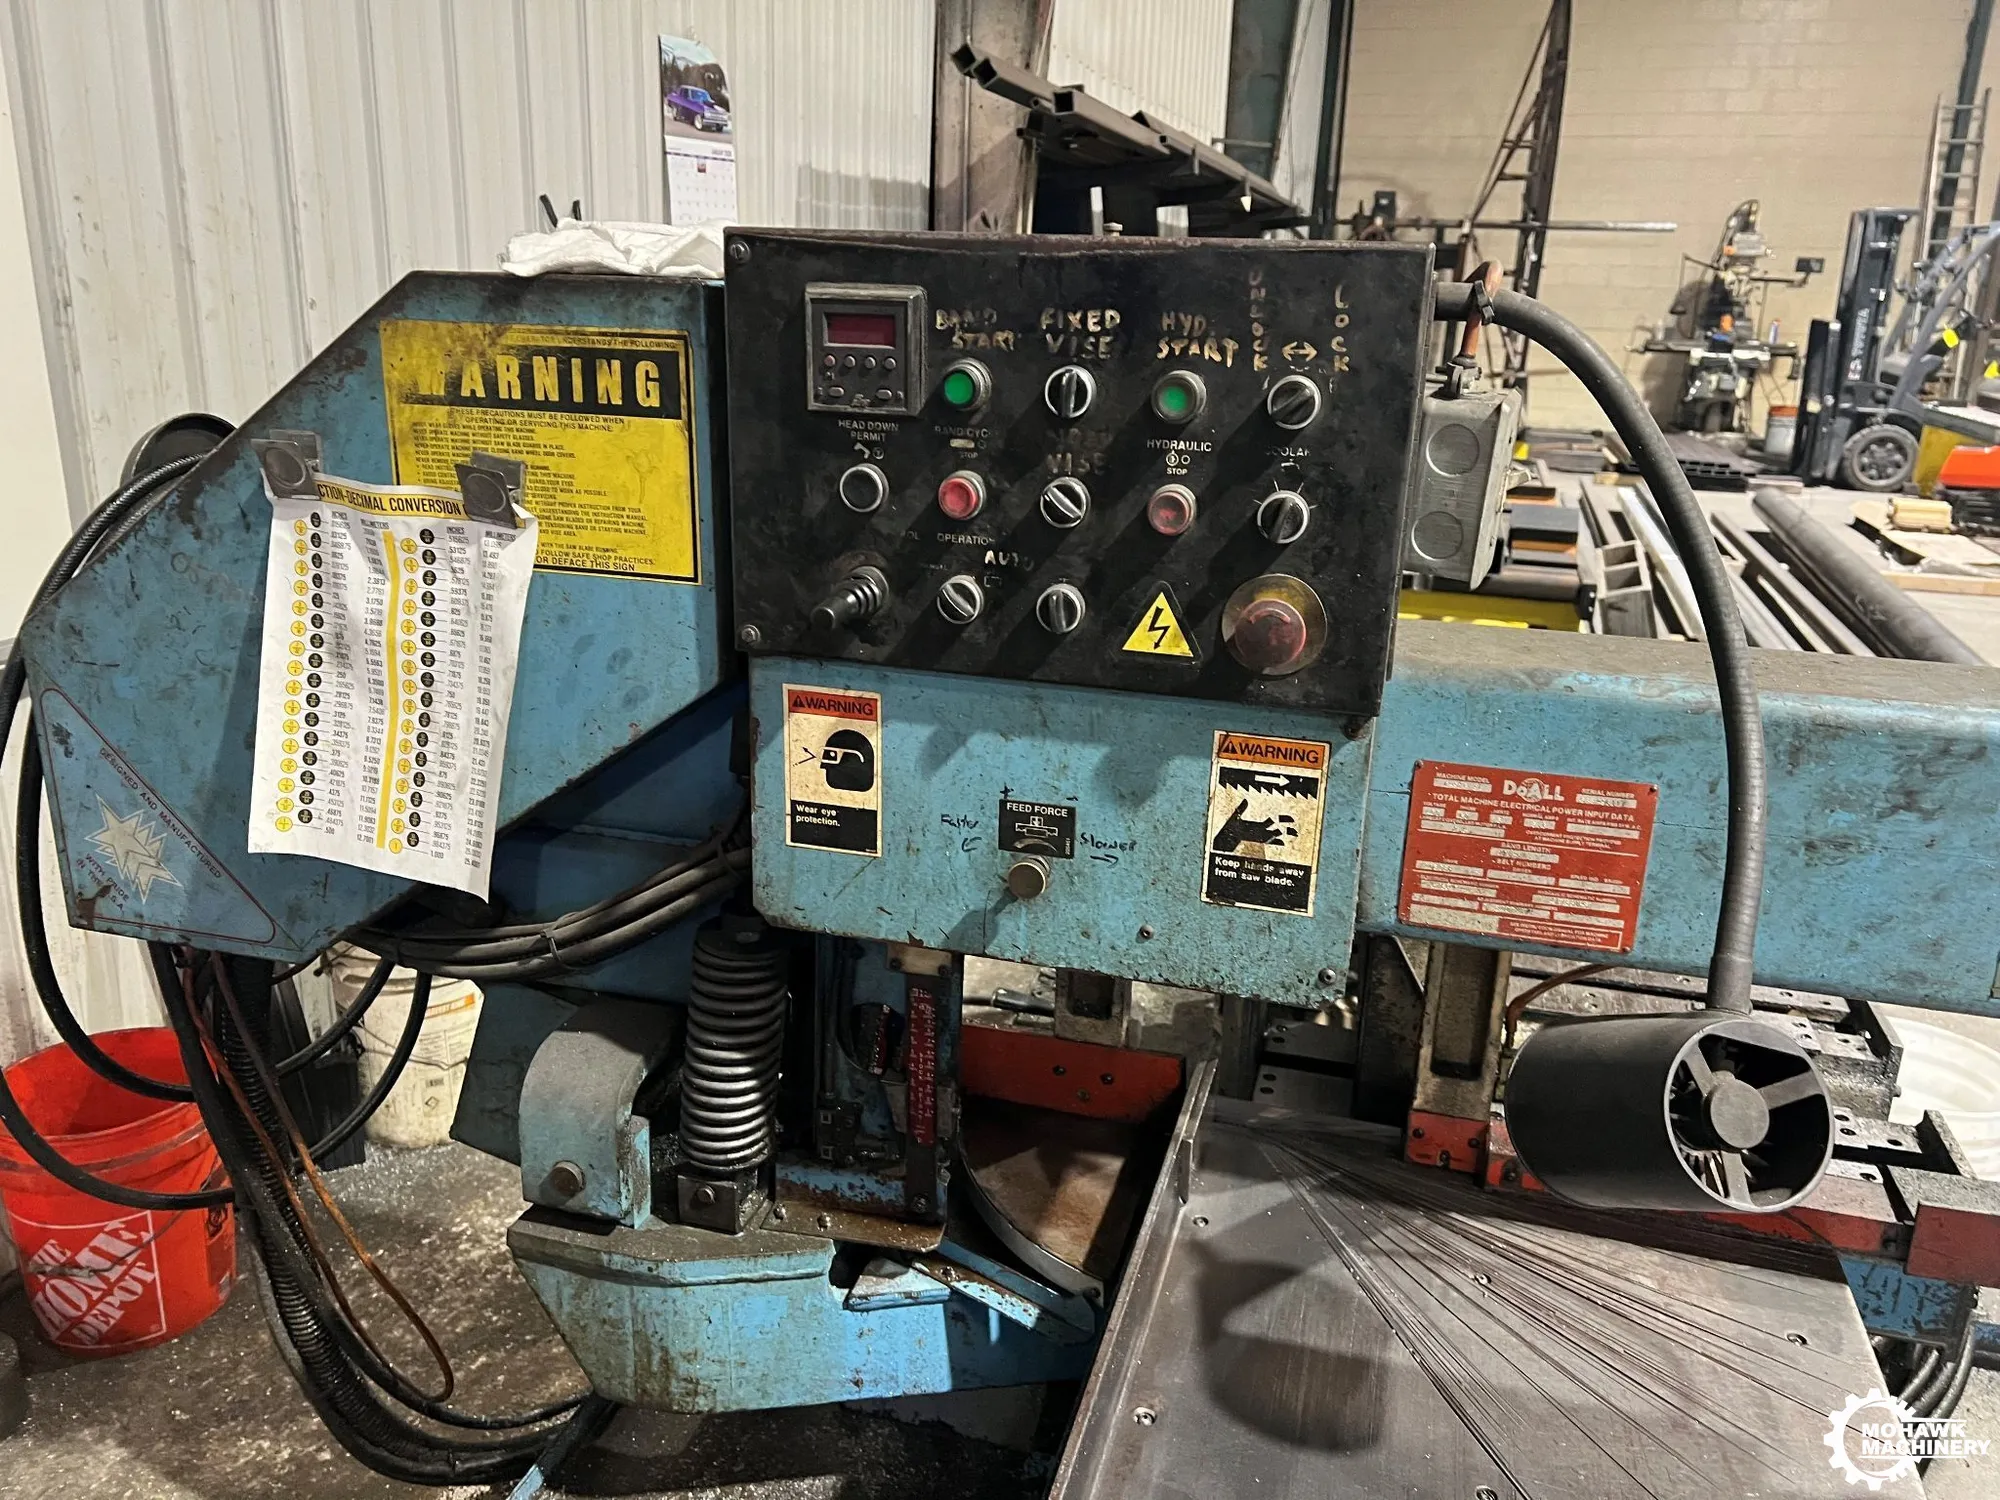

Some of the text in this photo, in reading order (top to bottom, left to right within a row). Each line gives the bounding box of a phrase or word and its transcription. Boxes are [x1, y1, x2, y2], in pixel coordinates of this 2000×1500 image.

[1040, 307, 1121, 332] FIXED
[1330, 284, 1350, 372] LOCK
[1046, 332, 1114, 359] VISE
[1157, 336, 1240, 368] START
[465, 417, 505, 425] OPERATING
[520, 420, 557, 429] SERVICING
[476, 409, 525, 420] PRECAUTIONS
[527, 412, 546, 420] MUST
[560, 414, 600, 423] FOLLOWED
[601, 416, 625, 424] WHEN
[838, 420, 899, 431] HEAD DOWN
[850, 431, 886, 442] PERMIT
[1147, 439, 1212, 452] HYDRAULIC
[1166, 467, 1188, 475] STOP
[317, 484, 387, 512] CTION-DECIMAL
[389, 498, 461, 516] CONVERSION
[536, 556, 635, 572] OR DEFACE THIS SIGN
[540, 549, 656, 566] FOLLOW SAFE SHOP PRACTICES.
[984, 550, 1034, 570] AUTO
[804, 696, 874, 716] WARNING
[1239, 742, 1319, 764] WARNING
[1502, 780, 1565, 802] DoALL
[99, 747, 222, 878] DESIGNED AND MANUFACTURED
[796, 804, 837, 817] Wear eye
[1006, 802, 1068, 817] FEED FORCE
[1433, 793, 1635, 822] TOTAL MACHINE ELECTRICAL POWER INPUT DATA
[796, 815, 841, 827] protection.
[1215, 856, 1305, 879] Keep hands away
[1215, 868, 1295, 887] from saw blade.
[34, 1220, 155, 1341] HOME
[70, 1261, 156, 1345] DEPOT
